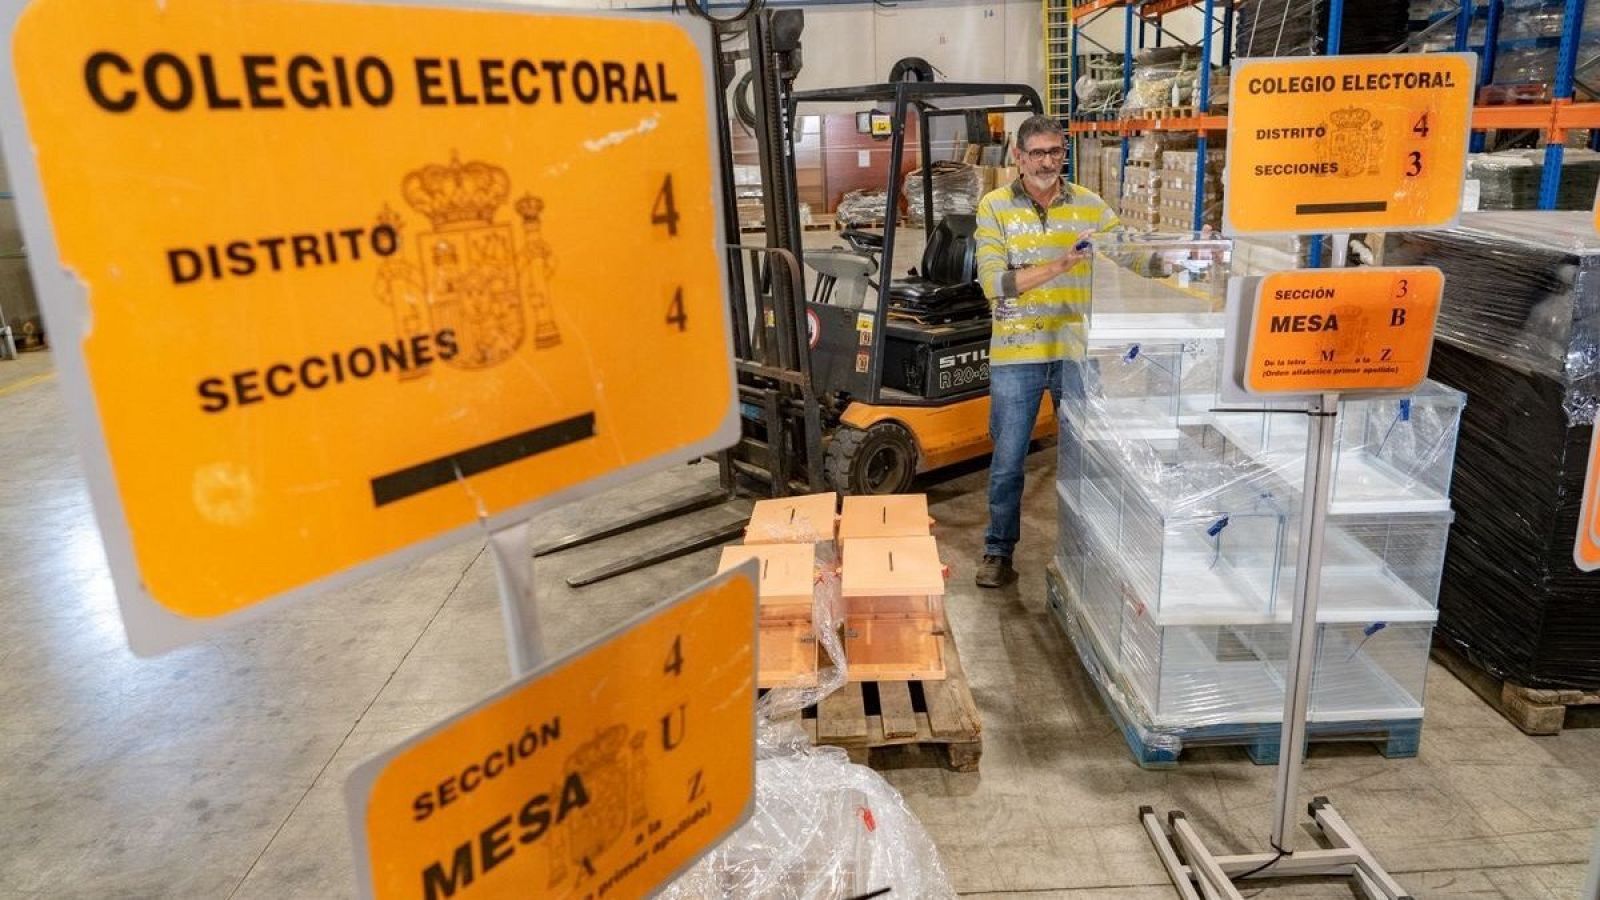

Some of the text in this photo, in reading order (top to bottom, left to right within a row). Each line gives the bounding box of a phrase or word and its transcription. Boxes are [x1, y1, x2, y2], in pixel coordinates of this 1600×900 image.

[84, 50, 677, 113] COLEGIO ELECTORAL
[1249, 71, 1455, 95] COLEGIO ELECTORAL
[1256, 112, 1430, 140] DISTRITO 4
[1255, 151, 1422, 177] SECCIONES 3
[166, 173, 680, 286] DISTRITO 4
[1275, 279, 1408, 301] SECCIÓN 3
[1270, 308, 1407, 333] MESA B
[197, 286, 688, 414] SECCIONES 4
[1321, 349, 1335, 361] M
[1380, 348, 1392, 361] Z
[939, 371, 952, 389] R
[413, 635, 684, 821] SECCIÓN 4
[688, 769, 704, 802] Z
[421, 705, 686, 900] MESA U
